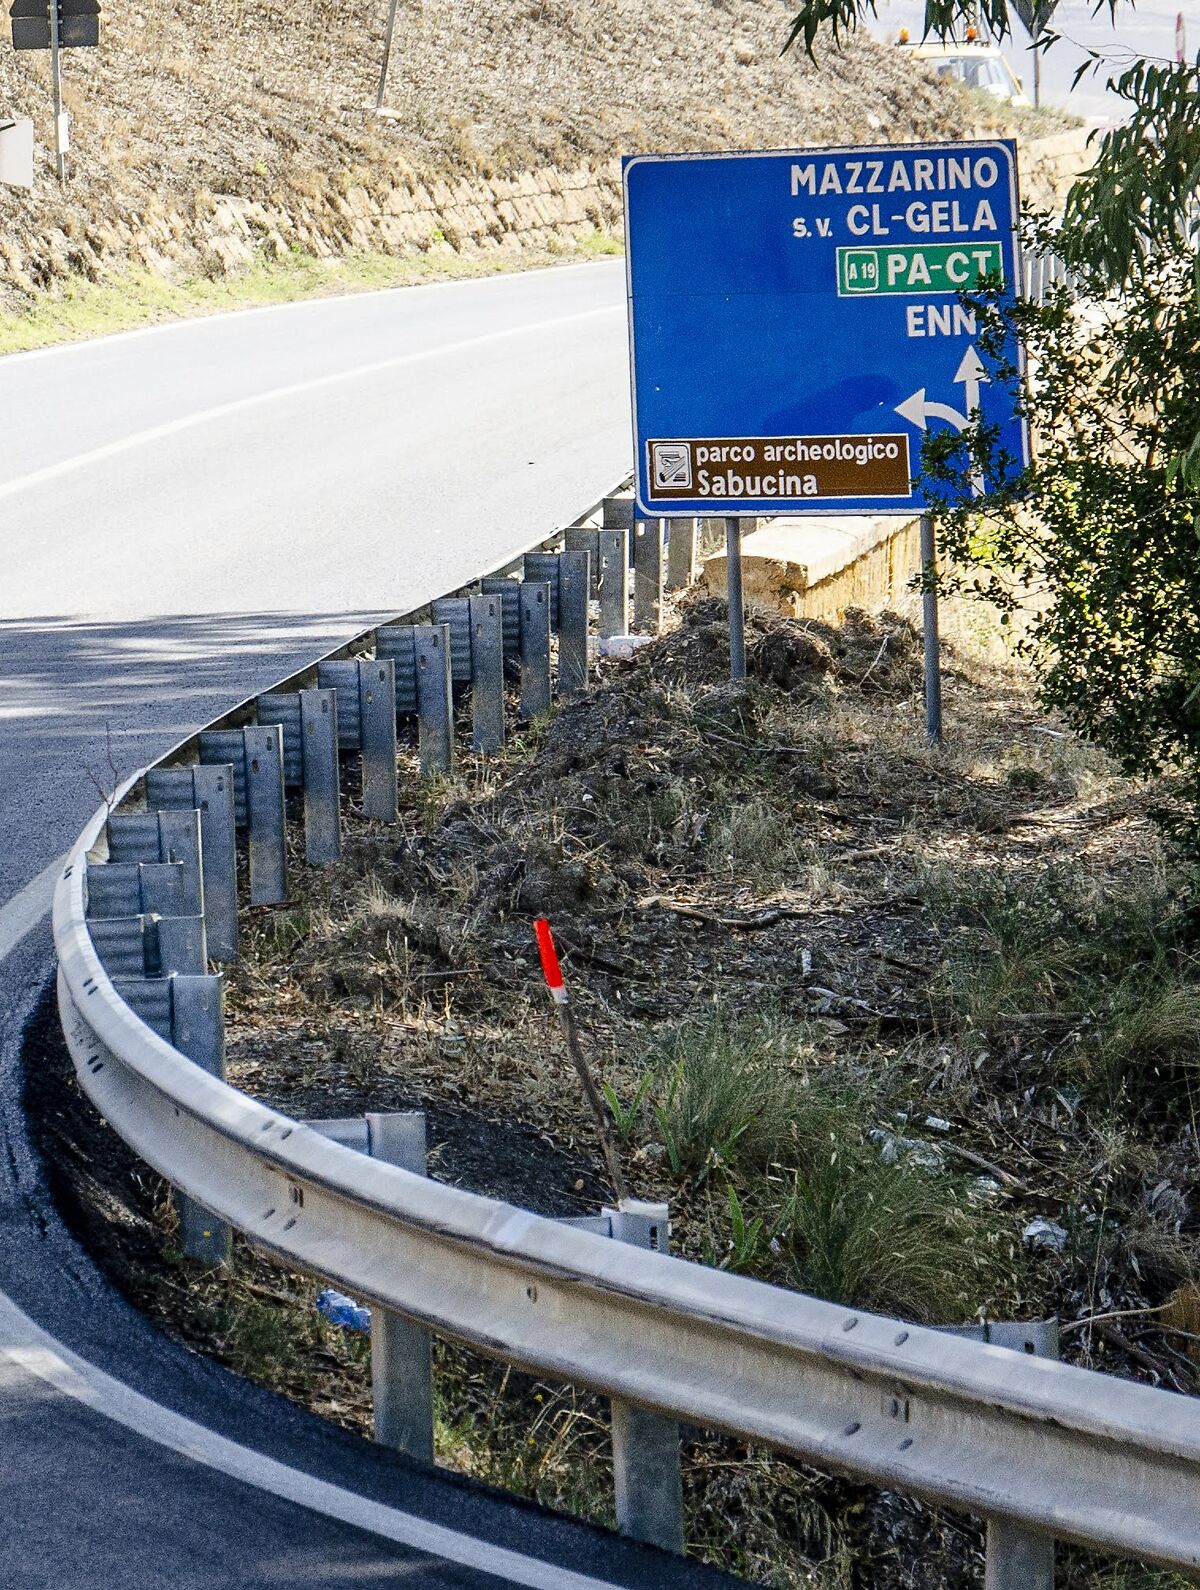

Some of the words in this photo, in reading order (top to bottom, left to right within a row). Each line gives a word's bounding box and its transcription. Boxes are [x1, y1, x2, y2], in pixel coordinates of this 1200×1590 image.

[790, 155, 999, 197] MAZZARINO
[846, 199, 998, 236] CL-GELA
[887, 250, 993, 286] PA-CT
[696, 445, 756, 466] parco
[764, 438, 899, 465] archeologico
[698, 468, 818, 496] Sabucina
